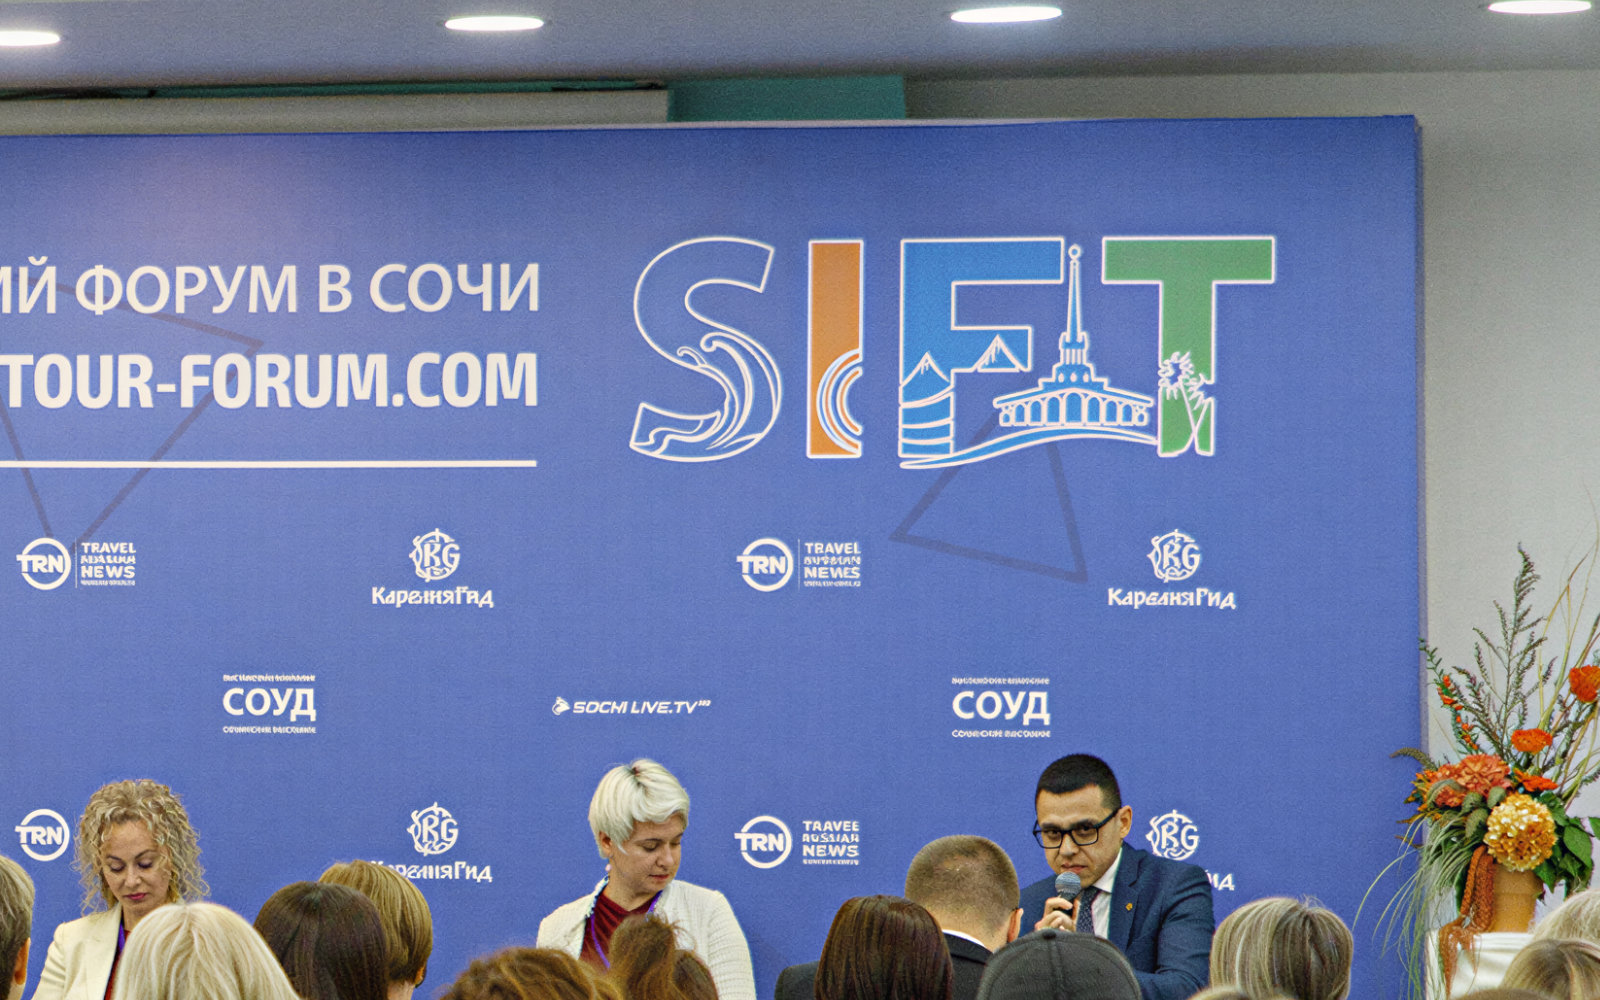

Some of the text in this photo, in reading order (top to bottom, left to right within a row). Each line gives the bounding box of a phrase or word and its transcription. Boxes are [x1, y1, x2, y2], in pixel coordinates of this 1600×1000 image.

[75, 264, 298, 316] ФОРУМ
[318, 264, 353, 313] В
[369, 263, 539, 313] СОЧИ
[628, 235, 1276, 470] SIFT
[81, 542, 136, 554] TRAVEL
[804, 542, 861, 554] TRAVEL
[16, 554, 64, 573] TRN
[81, 565, 136, 579] NEWS
[736, 555, 786, 574] TRN
[222, 687, 317, 722] СОУД
[952, 690, 1051, 726] СОУД
[14, 825, 63, 845] TRN
[734, 833, 784, 852] TRN
[802, 844, 859, 857] NEWS
